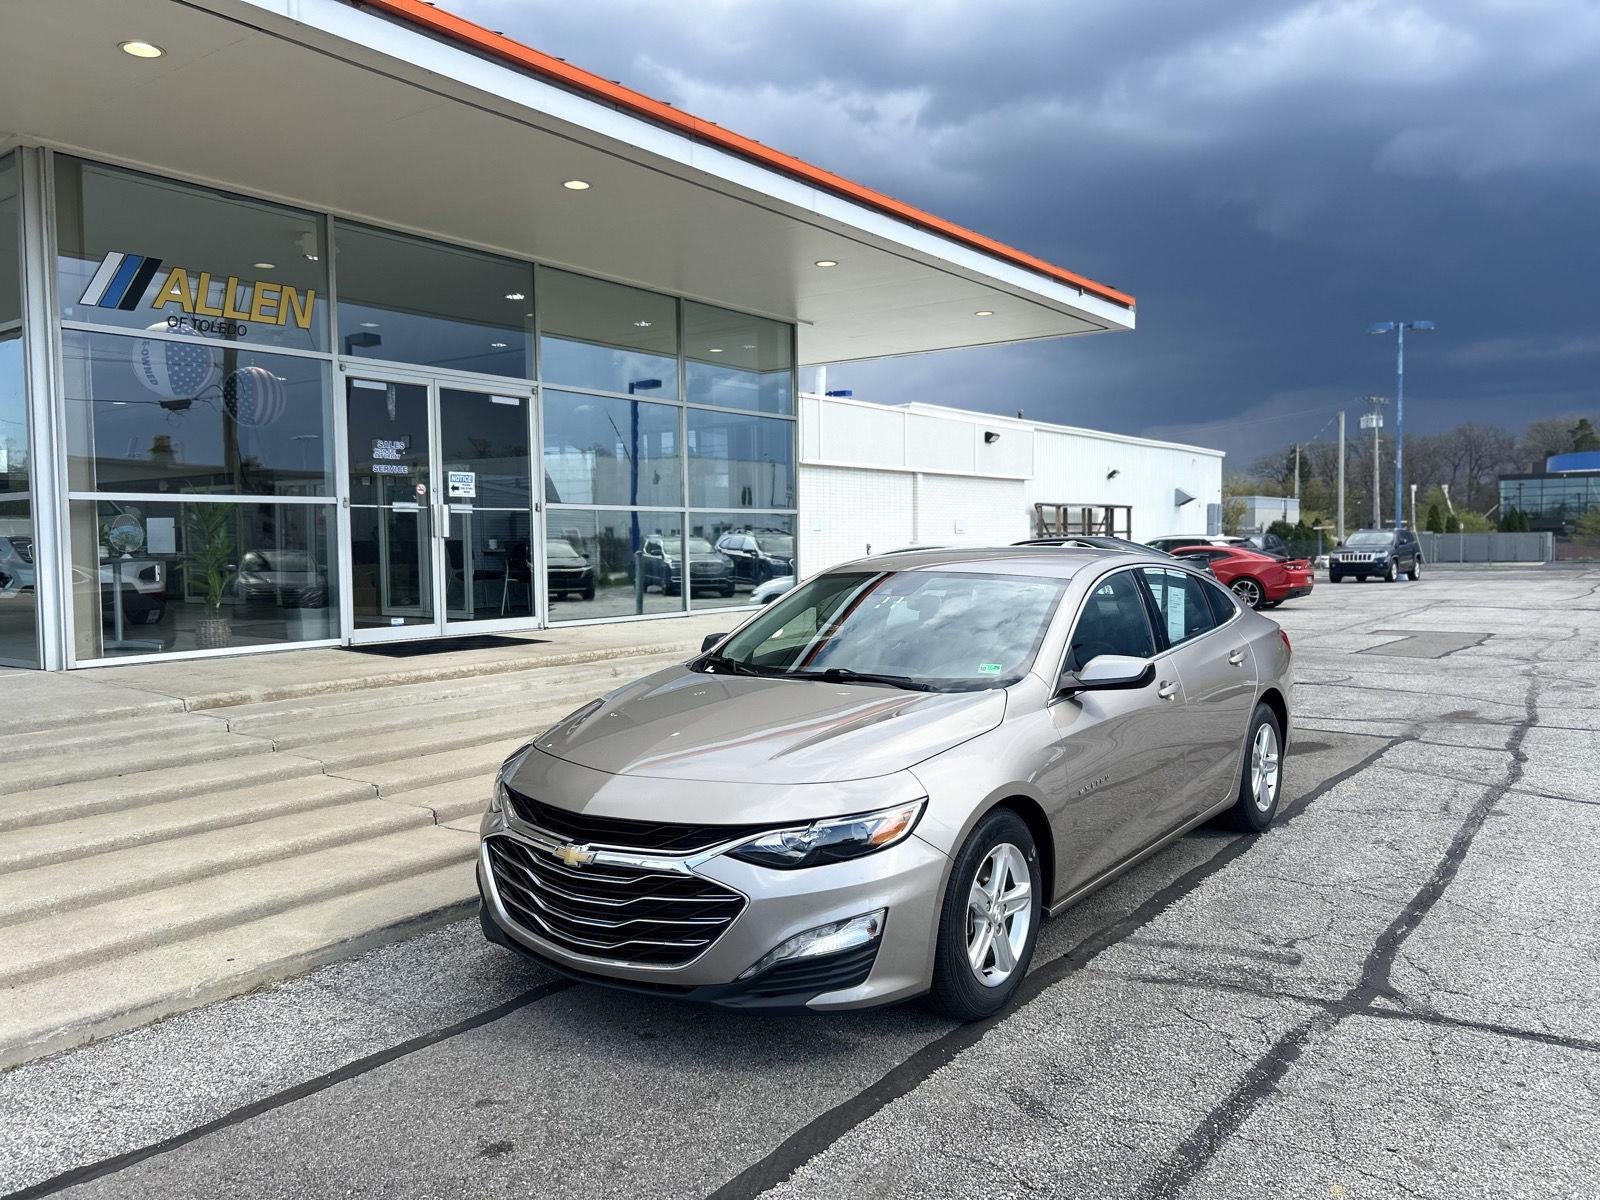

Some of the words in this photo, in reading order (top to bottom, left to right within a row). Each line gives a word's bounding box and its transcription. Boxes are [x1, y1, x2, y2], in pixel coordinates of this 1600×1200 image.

[152, 266, 316, 329] ALLEN
[167, 315, 188, 329] OF
[191, 318, 248, 337] TOLEDO
[377, 439, 406, 450] SALES
[372, 464, 409, 474] SERVICE
[451, 474, 473, 483] NOTICE
